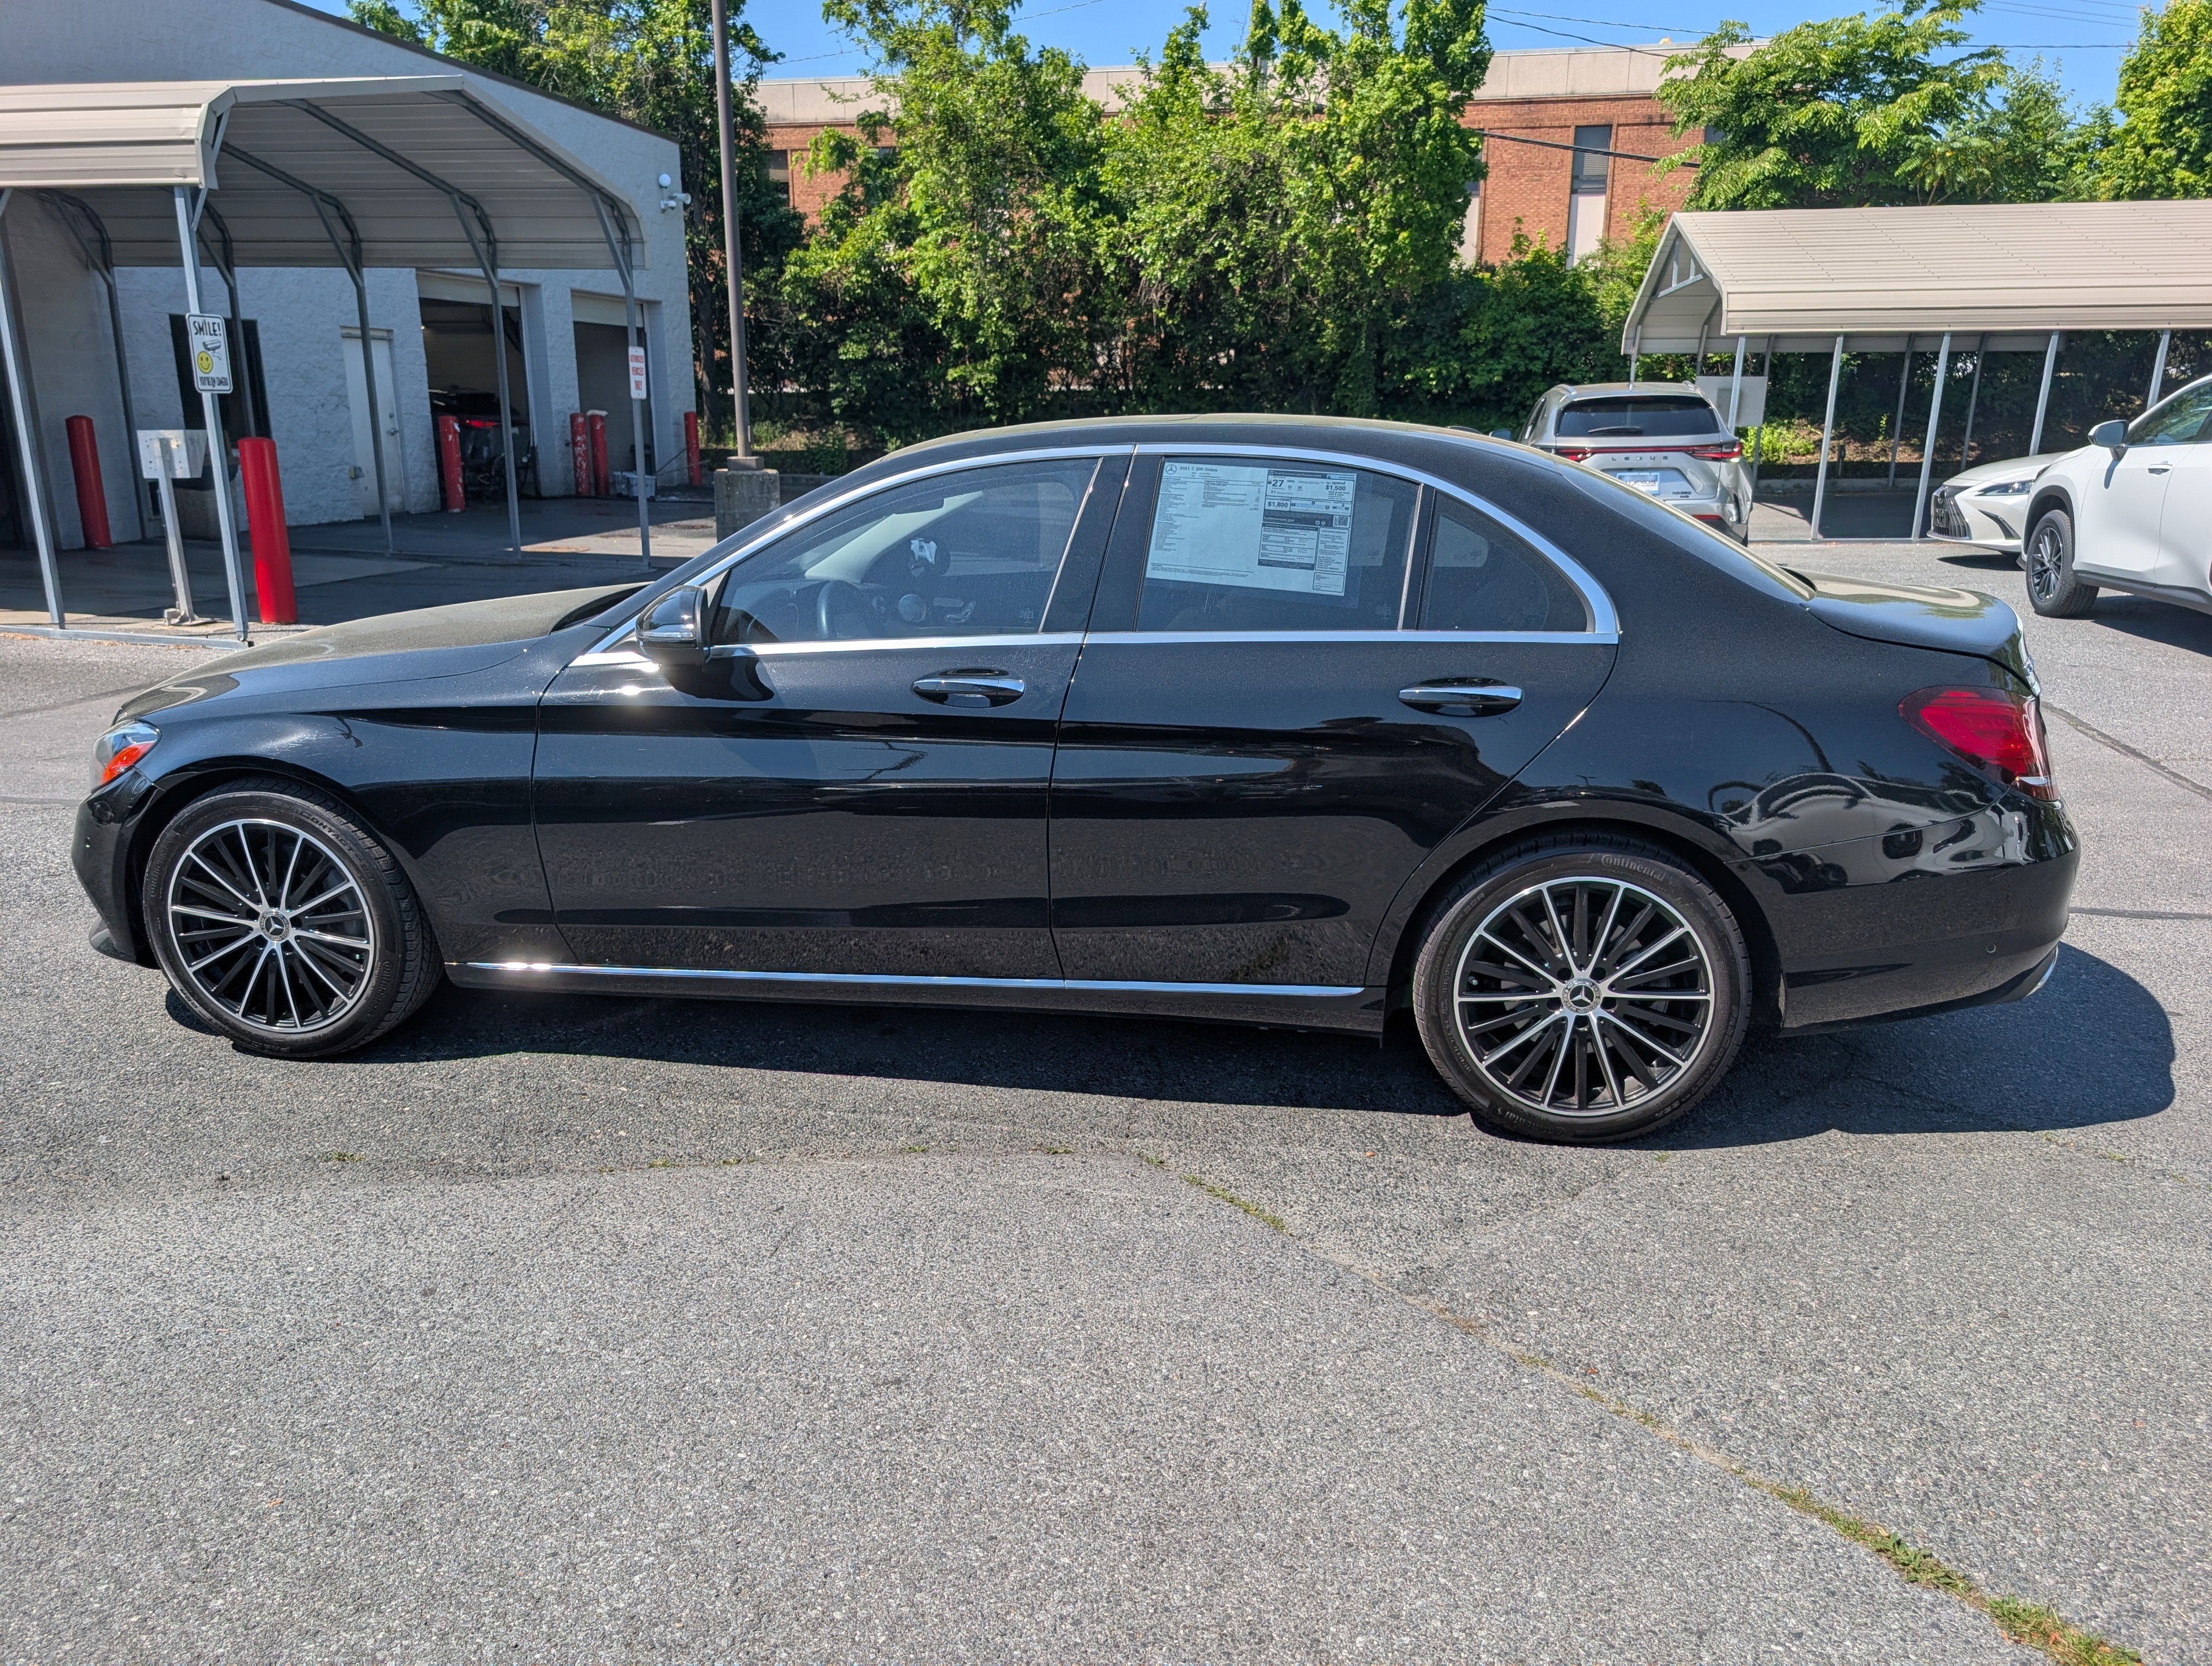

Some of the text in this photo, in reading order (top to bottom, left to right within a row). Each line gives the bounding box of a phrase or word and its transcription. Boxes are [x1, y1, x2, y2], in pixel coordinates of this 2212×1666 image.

[193, 319, 222, 337] SMILE!
[1271, 479, 1284, 488] 27
[1600, 854, 1666, 882] Continental
